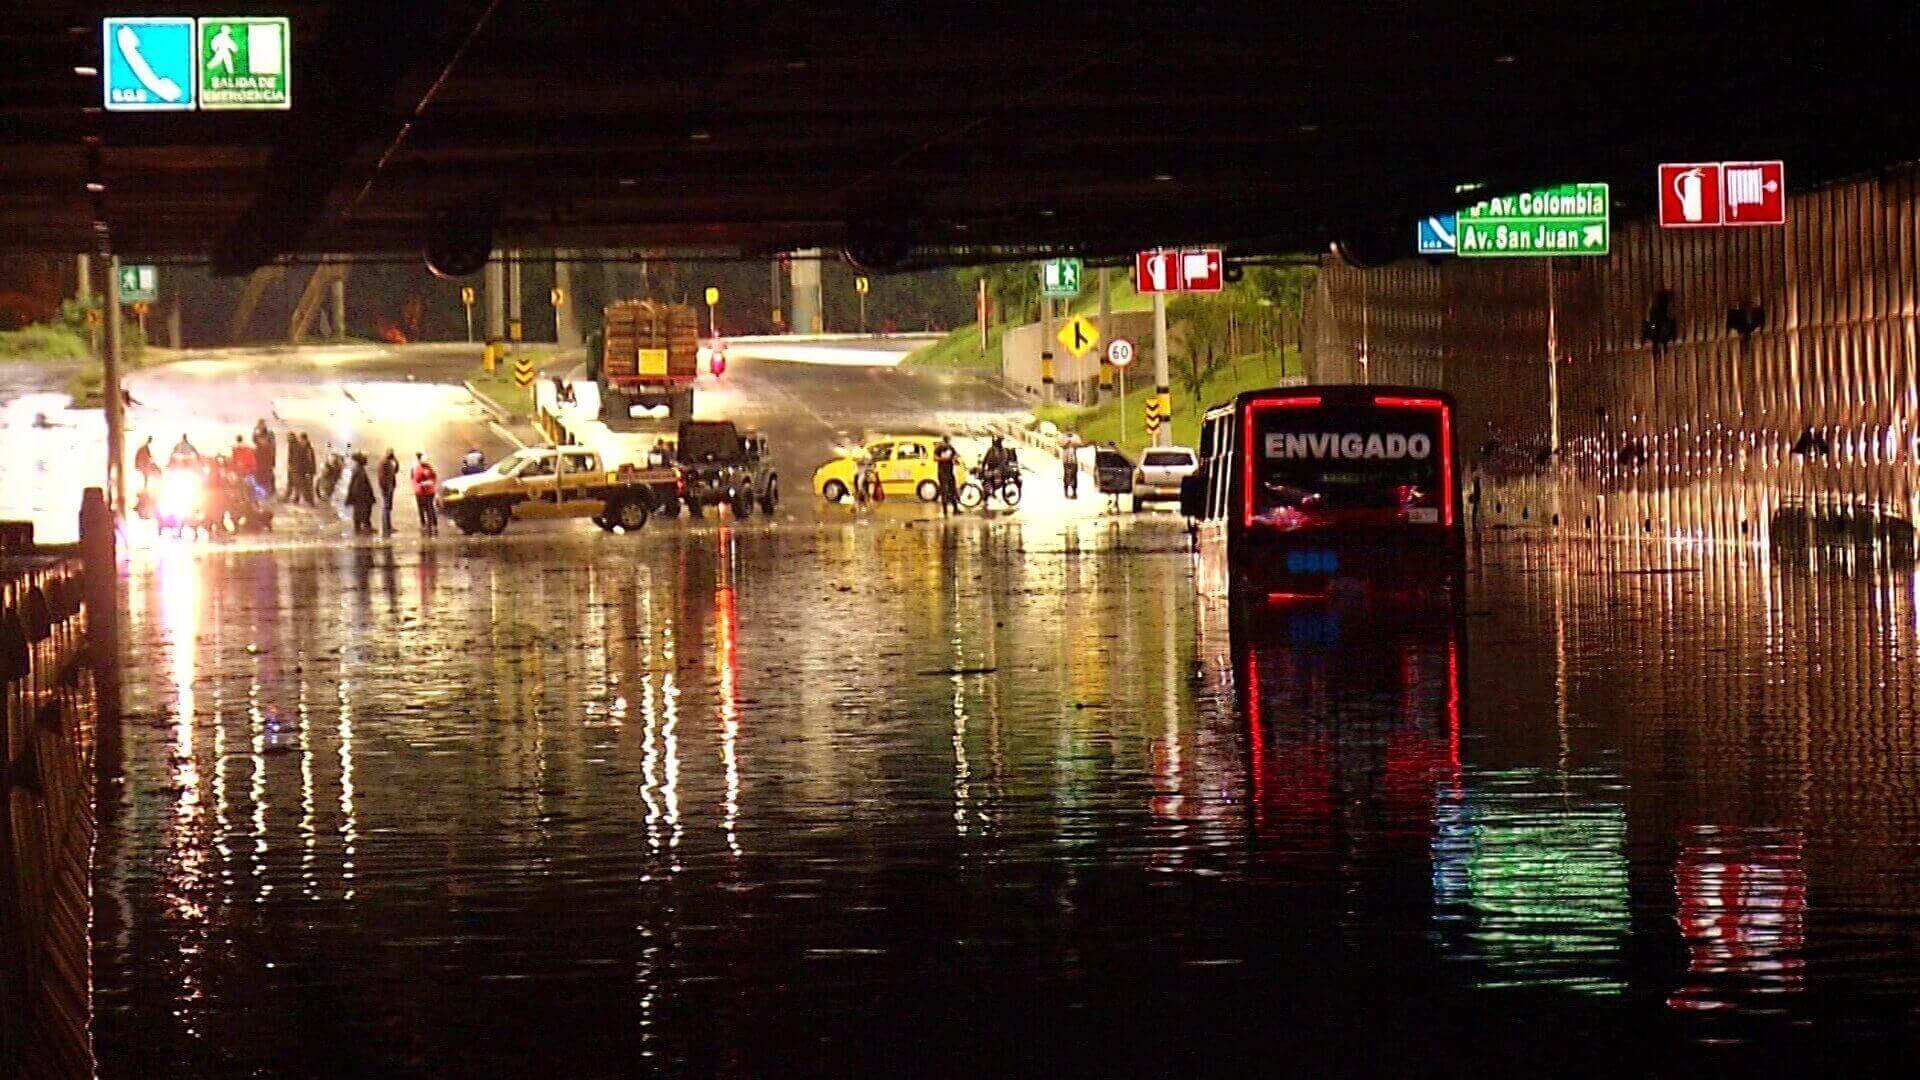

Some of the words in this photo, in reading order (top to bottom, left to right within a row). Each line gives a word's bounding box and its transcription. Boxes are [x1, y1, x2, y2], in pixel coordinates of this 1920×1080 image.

[211, 77, 257, 89] SALIDA
[260, 77, 276, 88] DE
[1490, 198, 1516, 216] Av.
[1519, 191, 1603, 215] Colombia
[1463, 225, 1493, 250] Av.
[1496, 225, 1531, 249] San
[1534, 224, 1579, 248] Juan
[1112, 345, 1129, 359] 60
[1264, 432, 1431, 459] ENVIGADO
